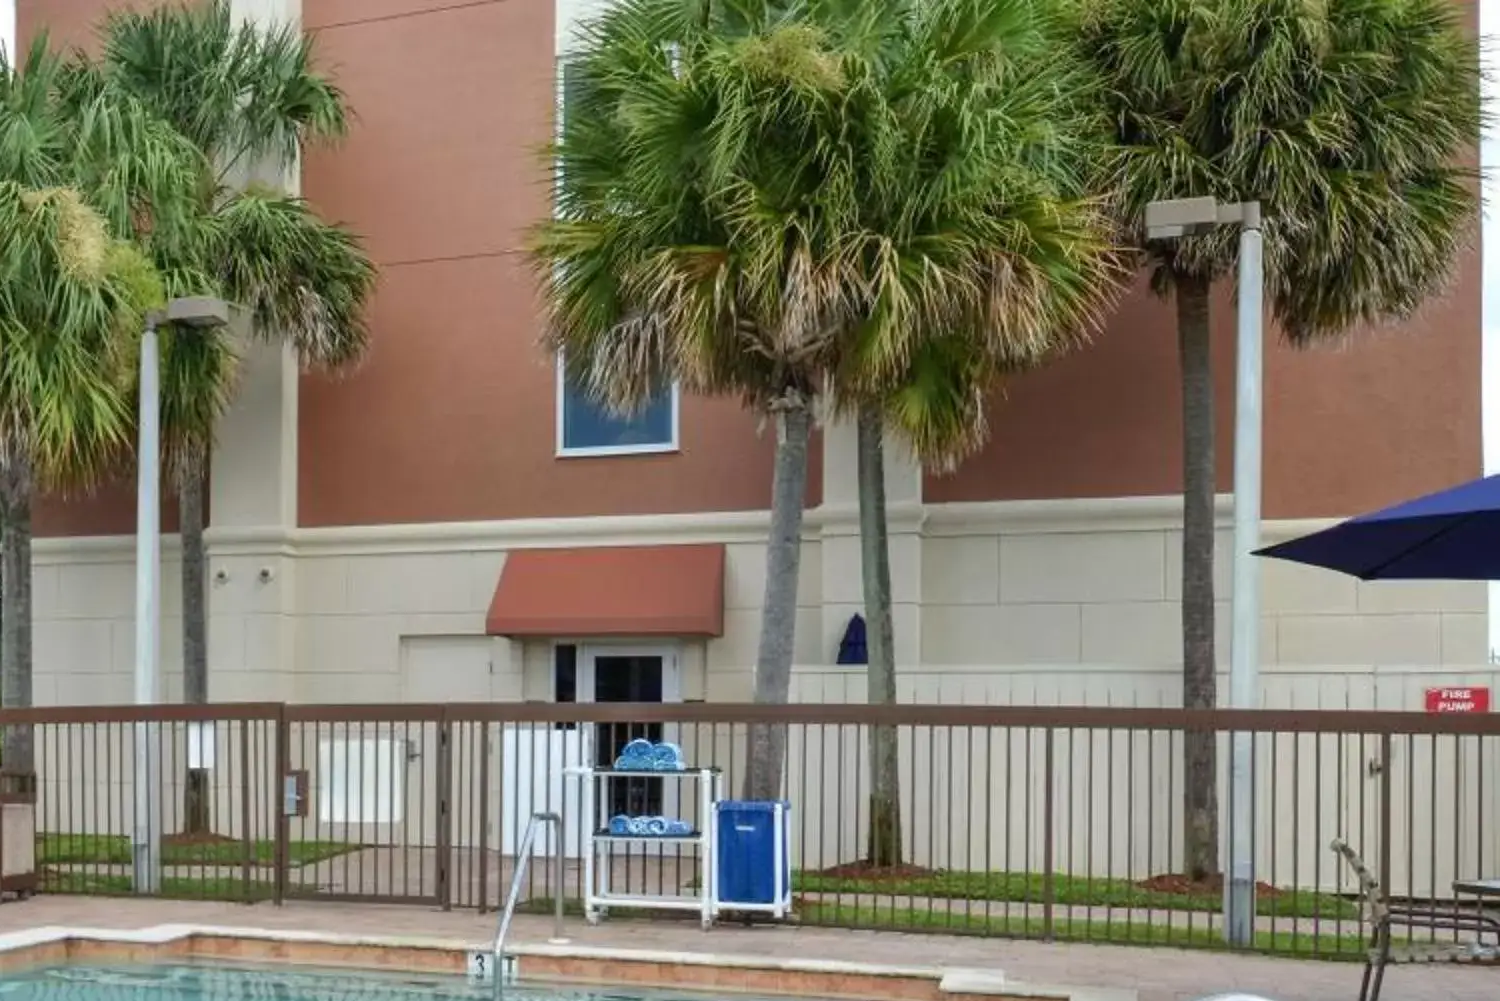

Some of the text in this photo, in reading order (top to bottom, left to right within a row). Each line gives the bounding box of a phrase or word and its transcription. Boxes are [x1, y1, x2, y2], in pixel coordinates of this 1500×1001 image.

[1441, 689, 1472, 699] FIRE
[1438, 701, 1475, 712] PUMP
[475, 953, 485, 979] 3
